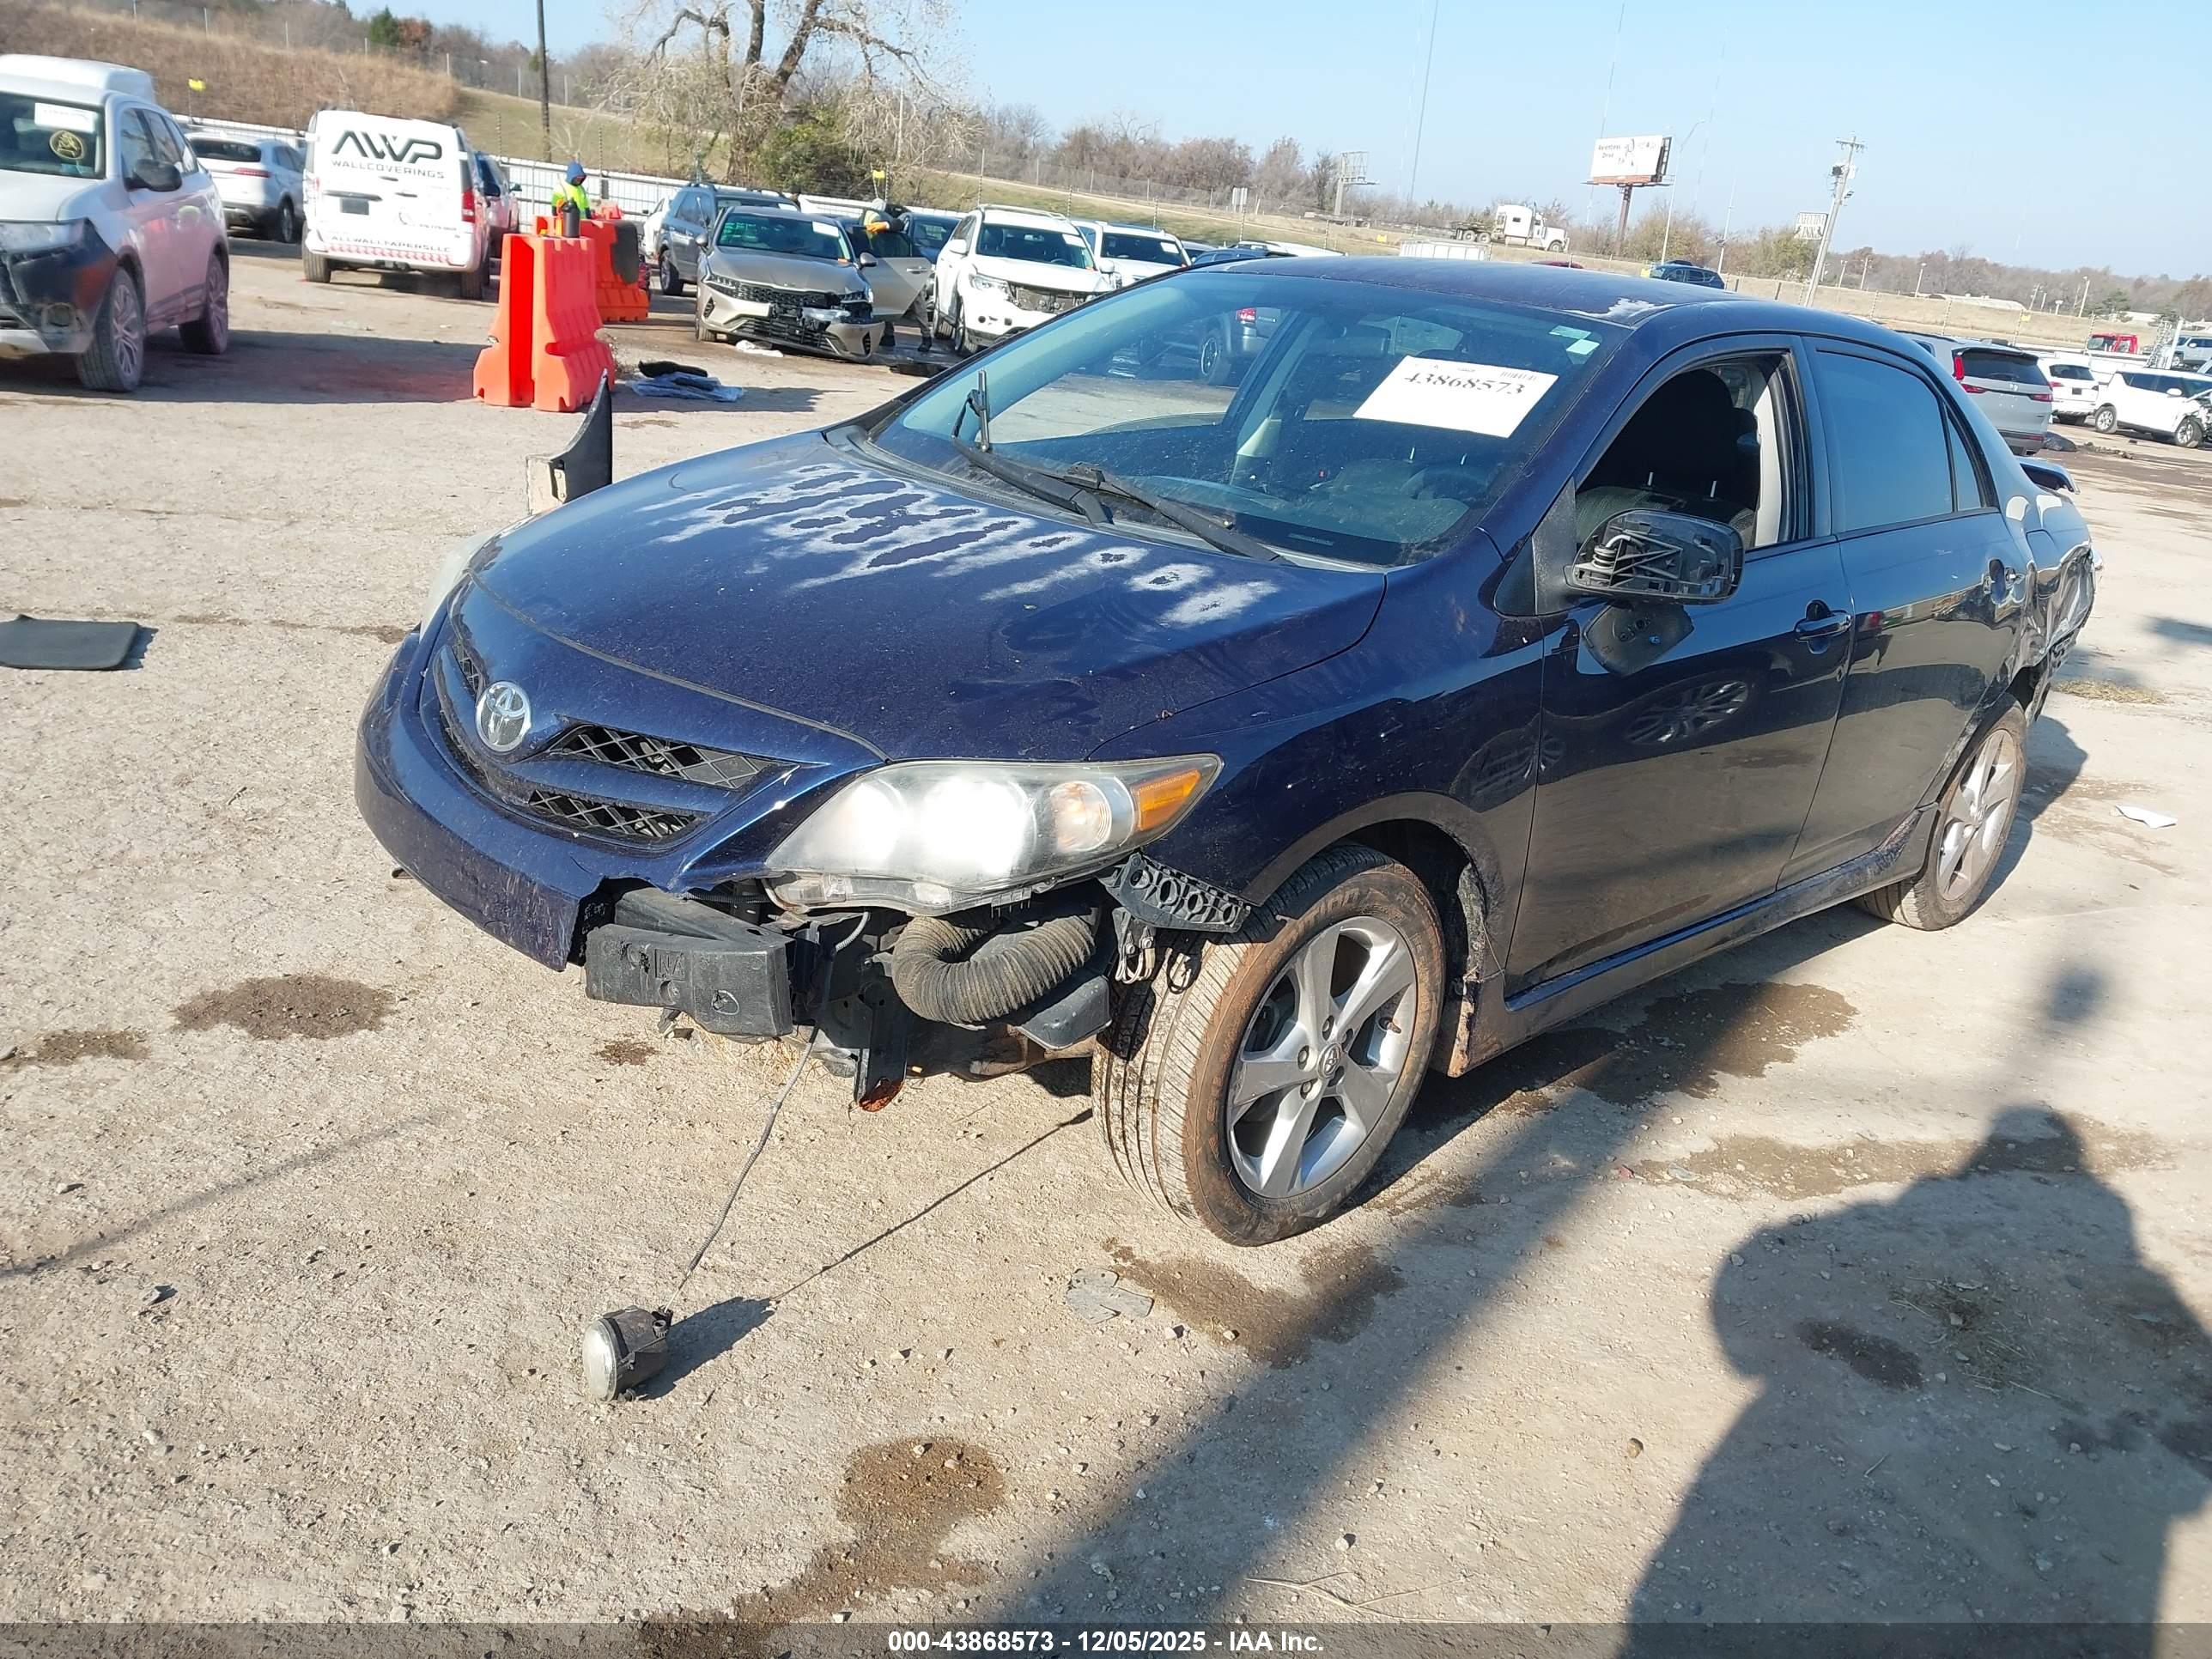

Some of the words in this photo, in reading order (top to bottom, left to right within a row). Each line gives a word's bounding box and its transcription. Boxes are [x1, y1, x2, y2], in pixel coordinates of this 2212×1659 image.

[332, 131, 441, 163] AWP
[331, 161, 445, 179] WALLCOVERINGS
[1404, 372, 1525, 394] 43868573
